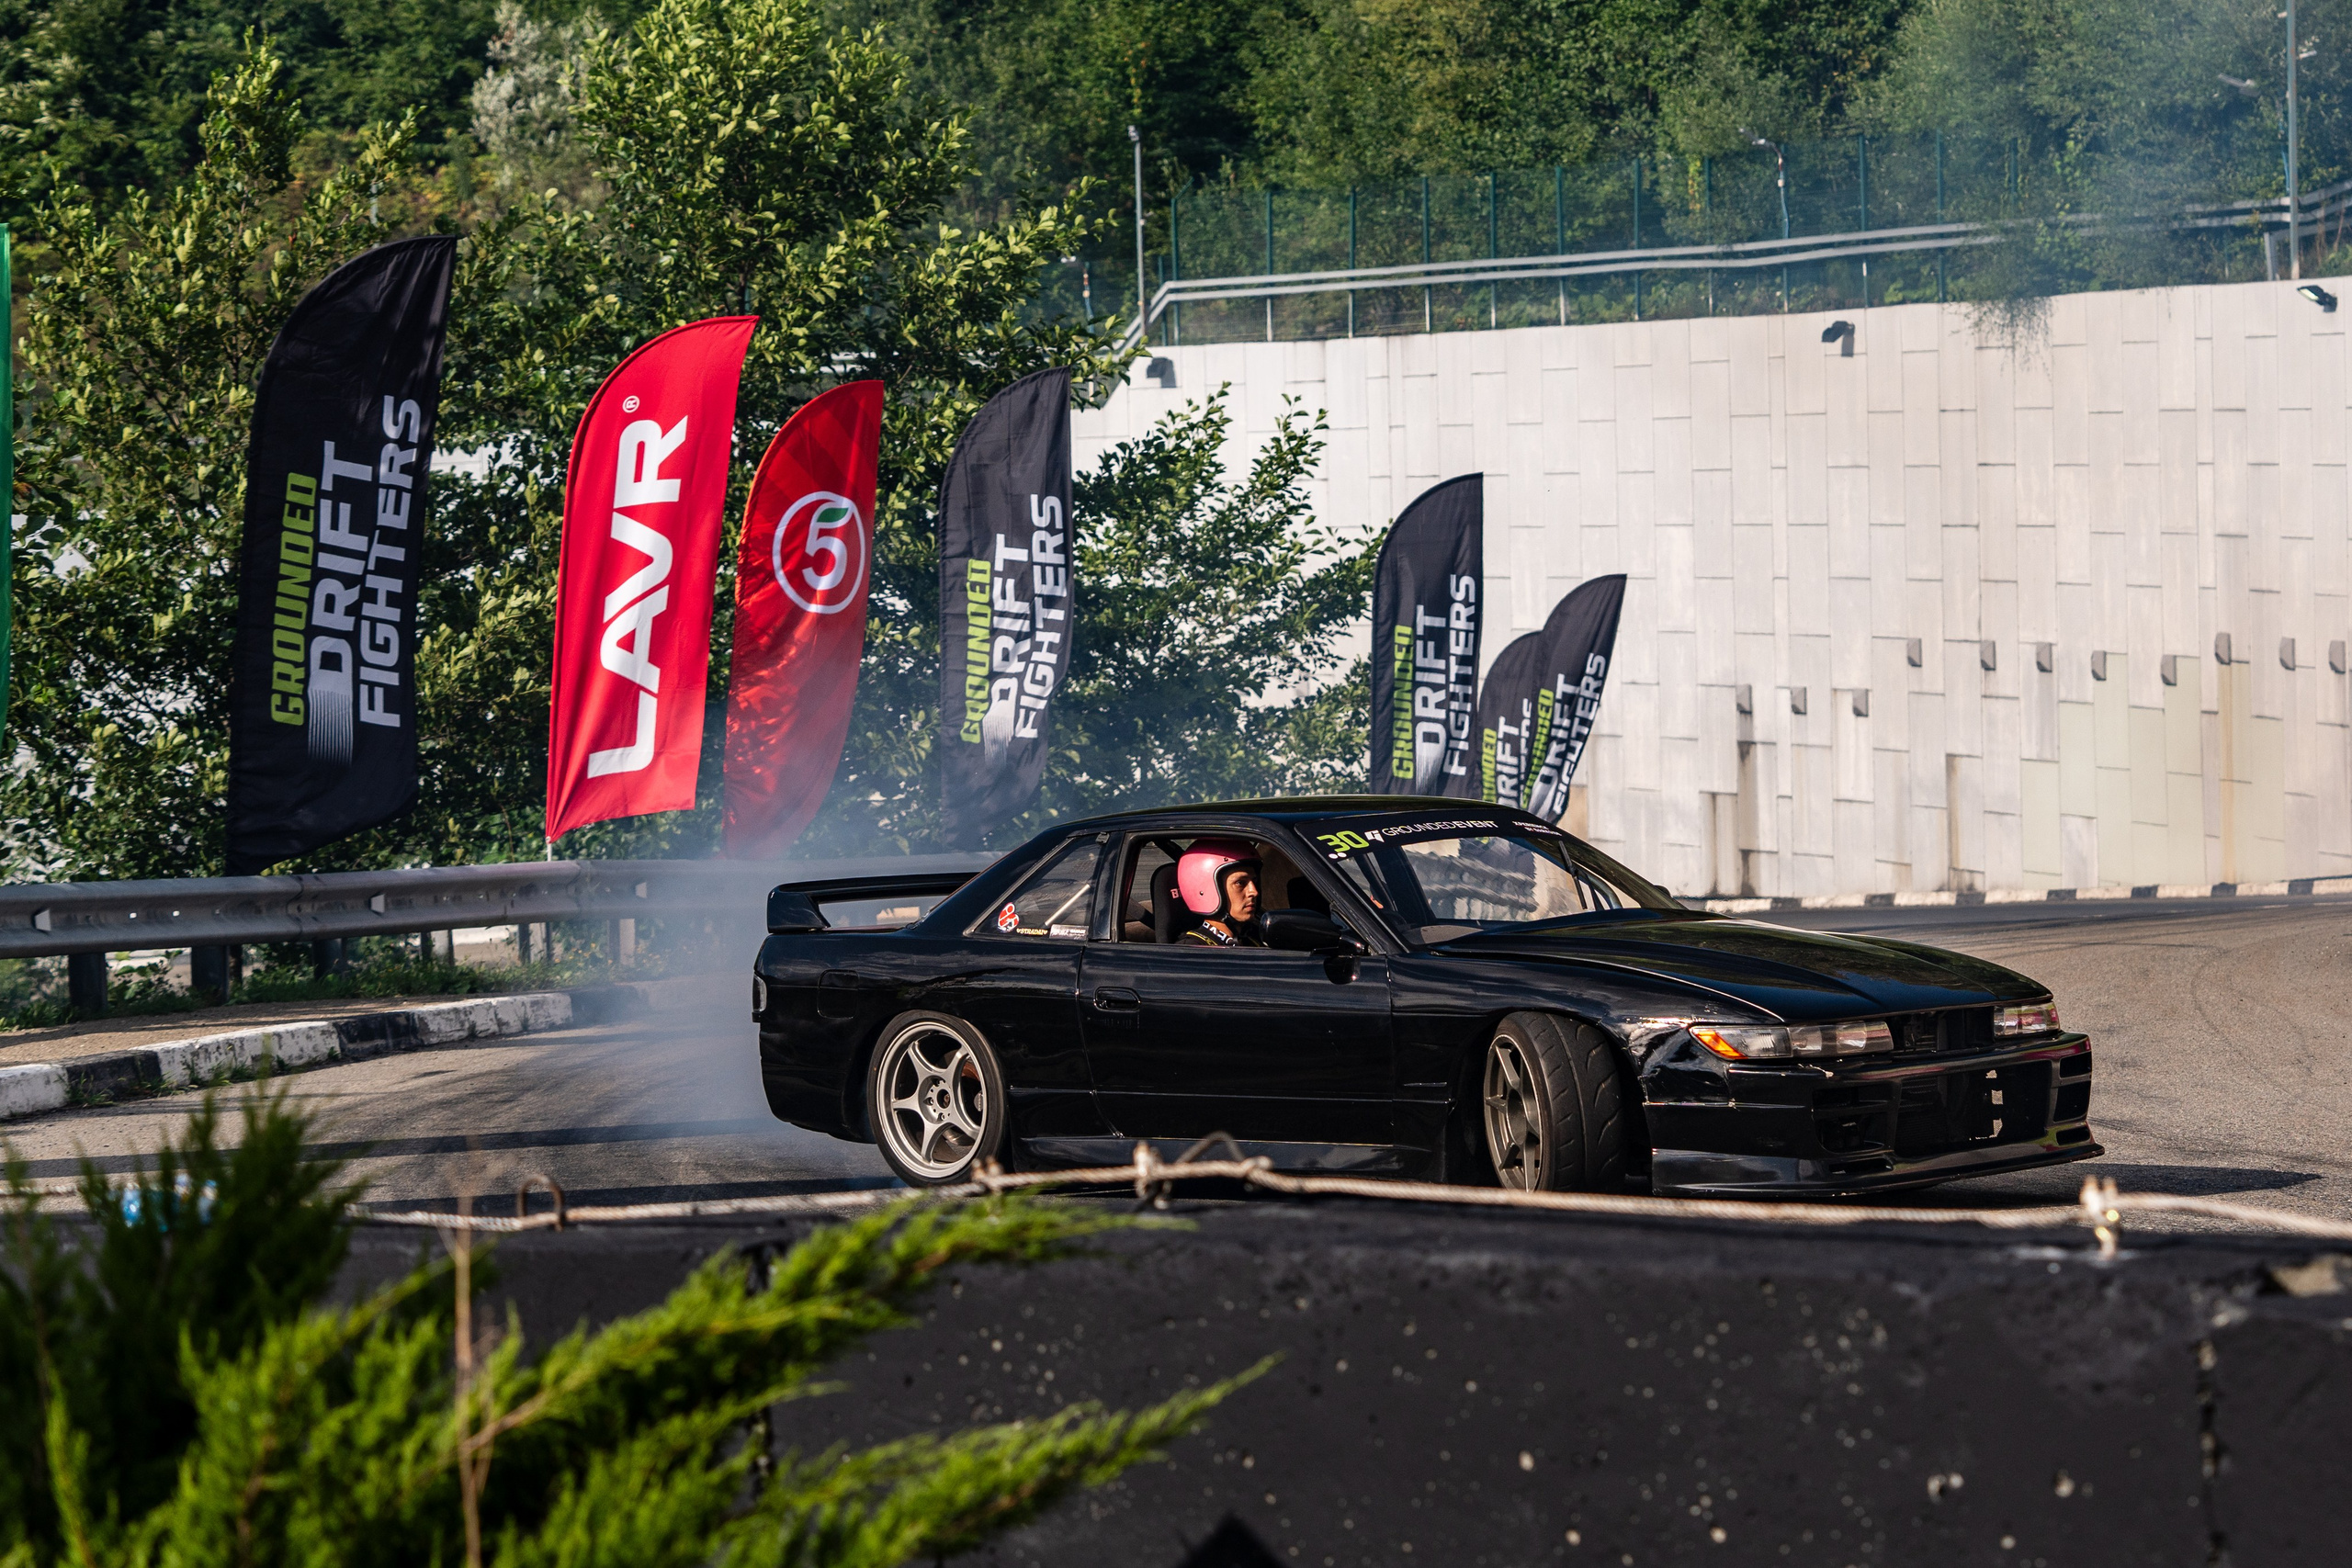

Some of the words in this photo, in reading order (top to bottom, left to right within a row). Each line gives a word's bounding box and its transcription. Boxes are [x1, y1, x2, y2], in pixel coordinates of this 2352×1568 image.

[270, 471, 317, 727] GROUNDED
[308, 440, 374, 735] DRIFT
[359, 395, 422, 728] FIGHTERS
[959, 558, 991, 744] GROUNDED
[981, 533, 1031, 739] DRIFT
[1014, 493, 1068, 739] FIGHTERS
[1392, 625, 1415, 780] GROUNDED
[1414, 604, 1447, 779] DRIFT
[1442, 573, 1476, 776] FIGHTERS
[1316, 829, 1370, 853] 30
[1381, 820, 1499, 837] GROUNDEDEVENT
